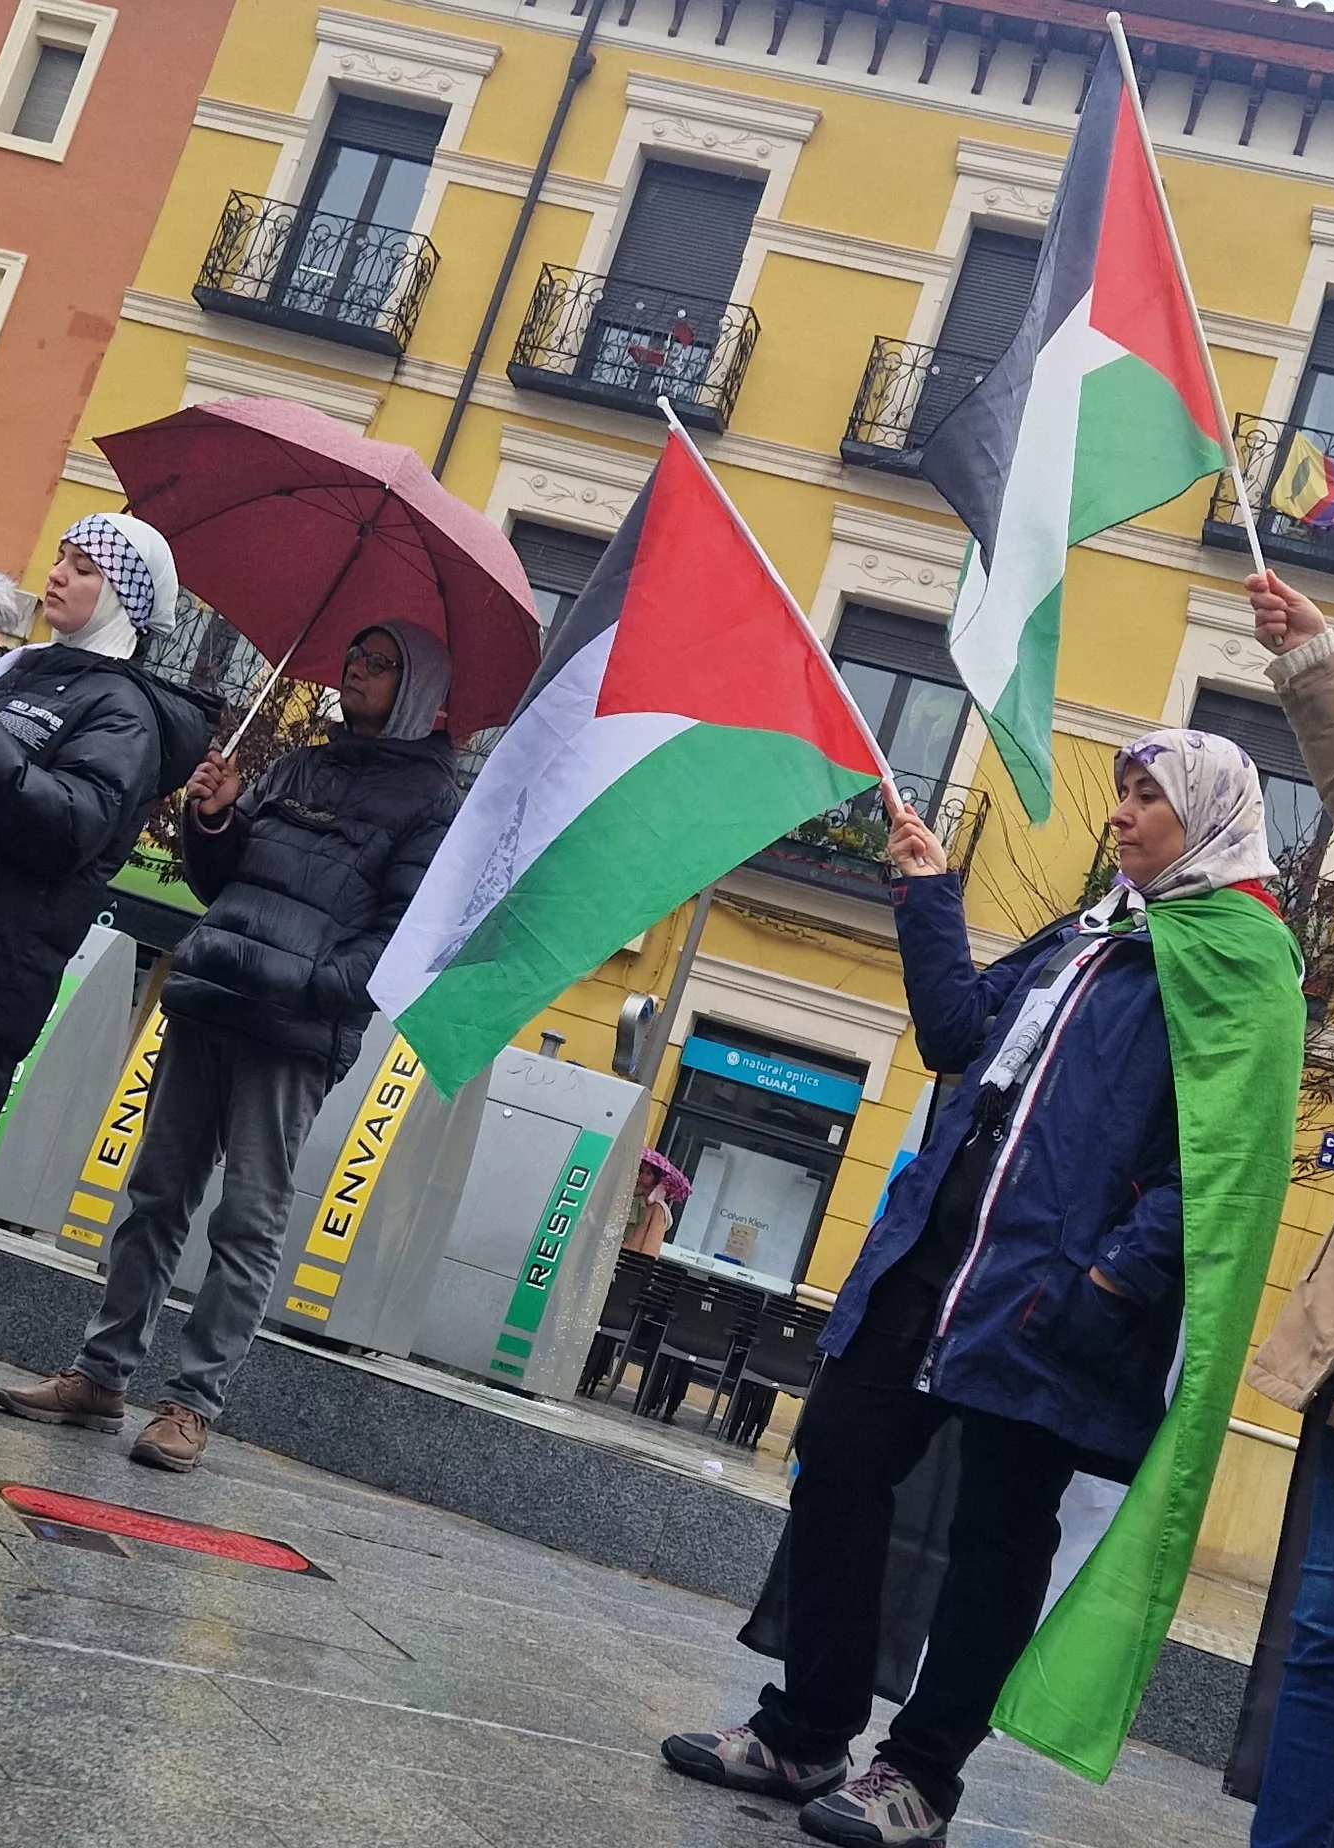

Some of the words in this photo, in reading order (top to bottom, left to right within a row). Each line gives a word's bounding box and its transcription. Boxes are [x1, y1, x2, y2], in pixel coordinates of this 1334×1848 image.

[742, 1057, 783, 1076] natural
[786, 1069, 820, 1088] optics
[757, 1075, 797, 1094] GUARA
[526, 1164, 591, 1290] RESTO
[720, 1208, 748, 1224] Calvin
[748, 1216, 770, 1231] Klein
